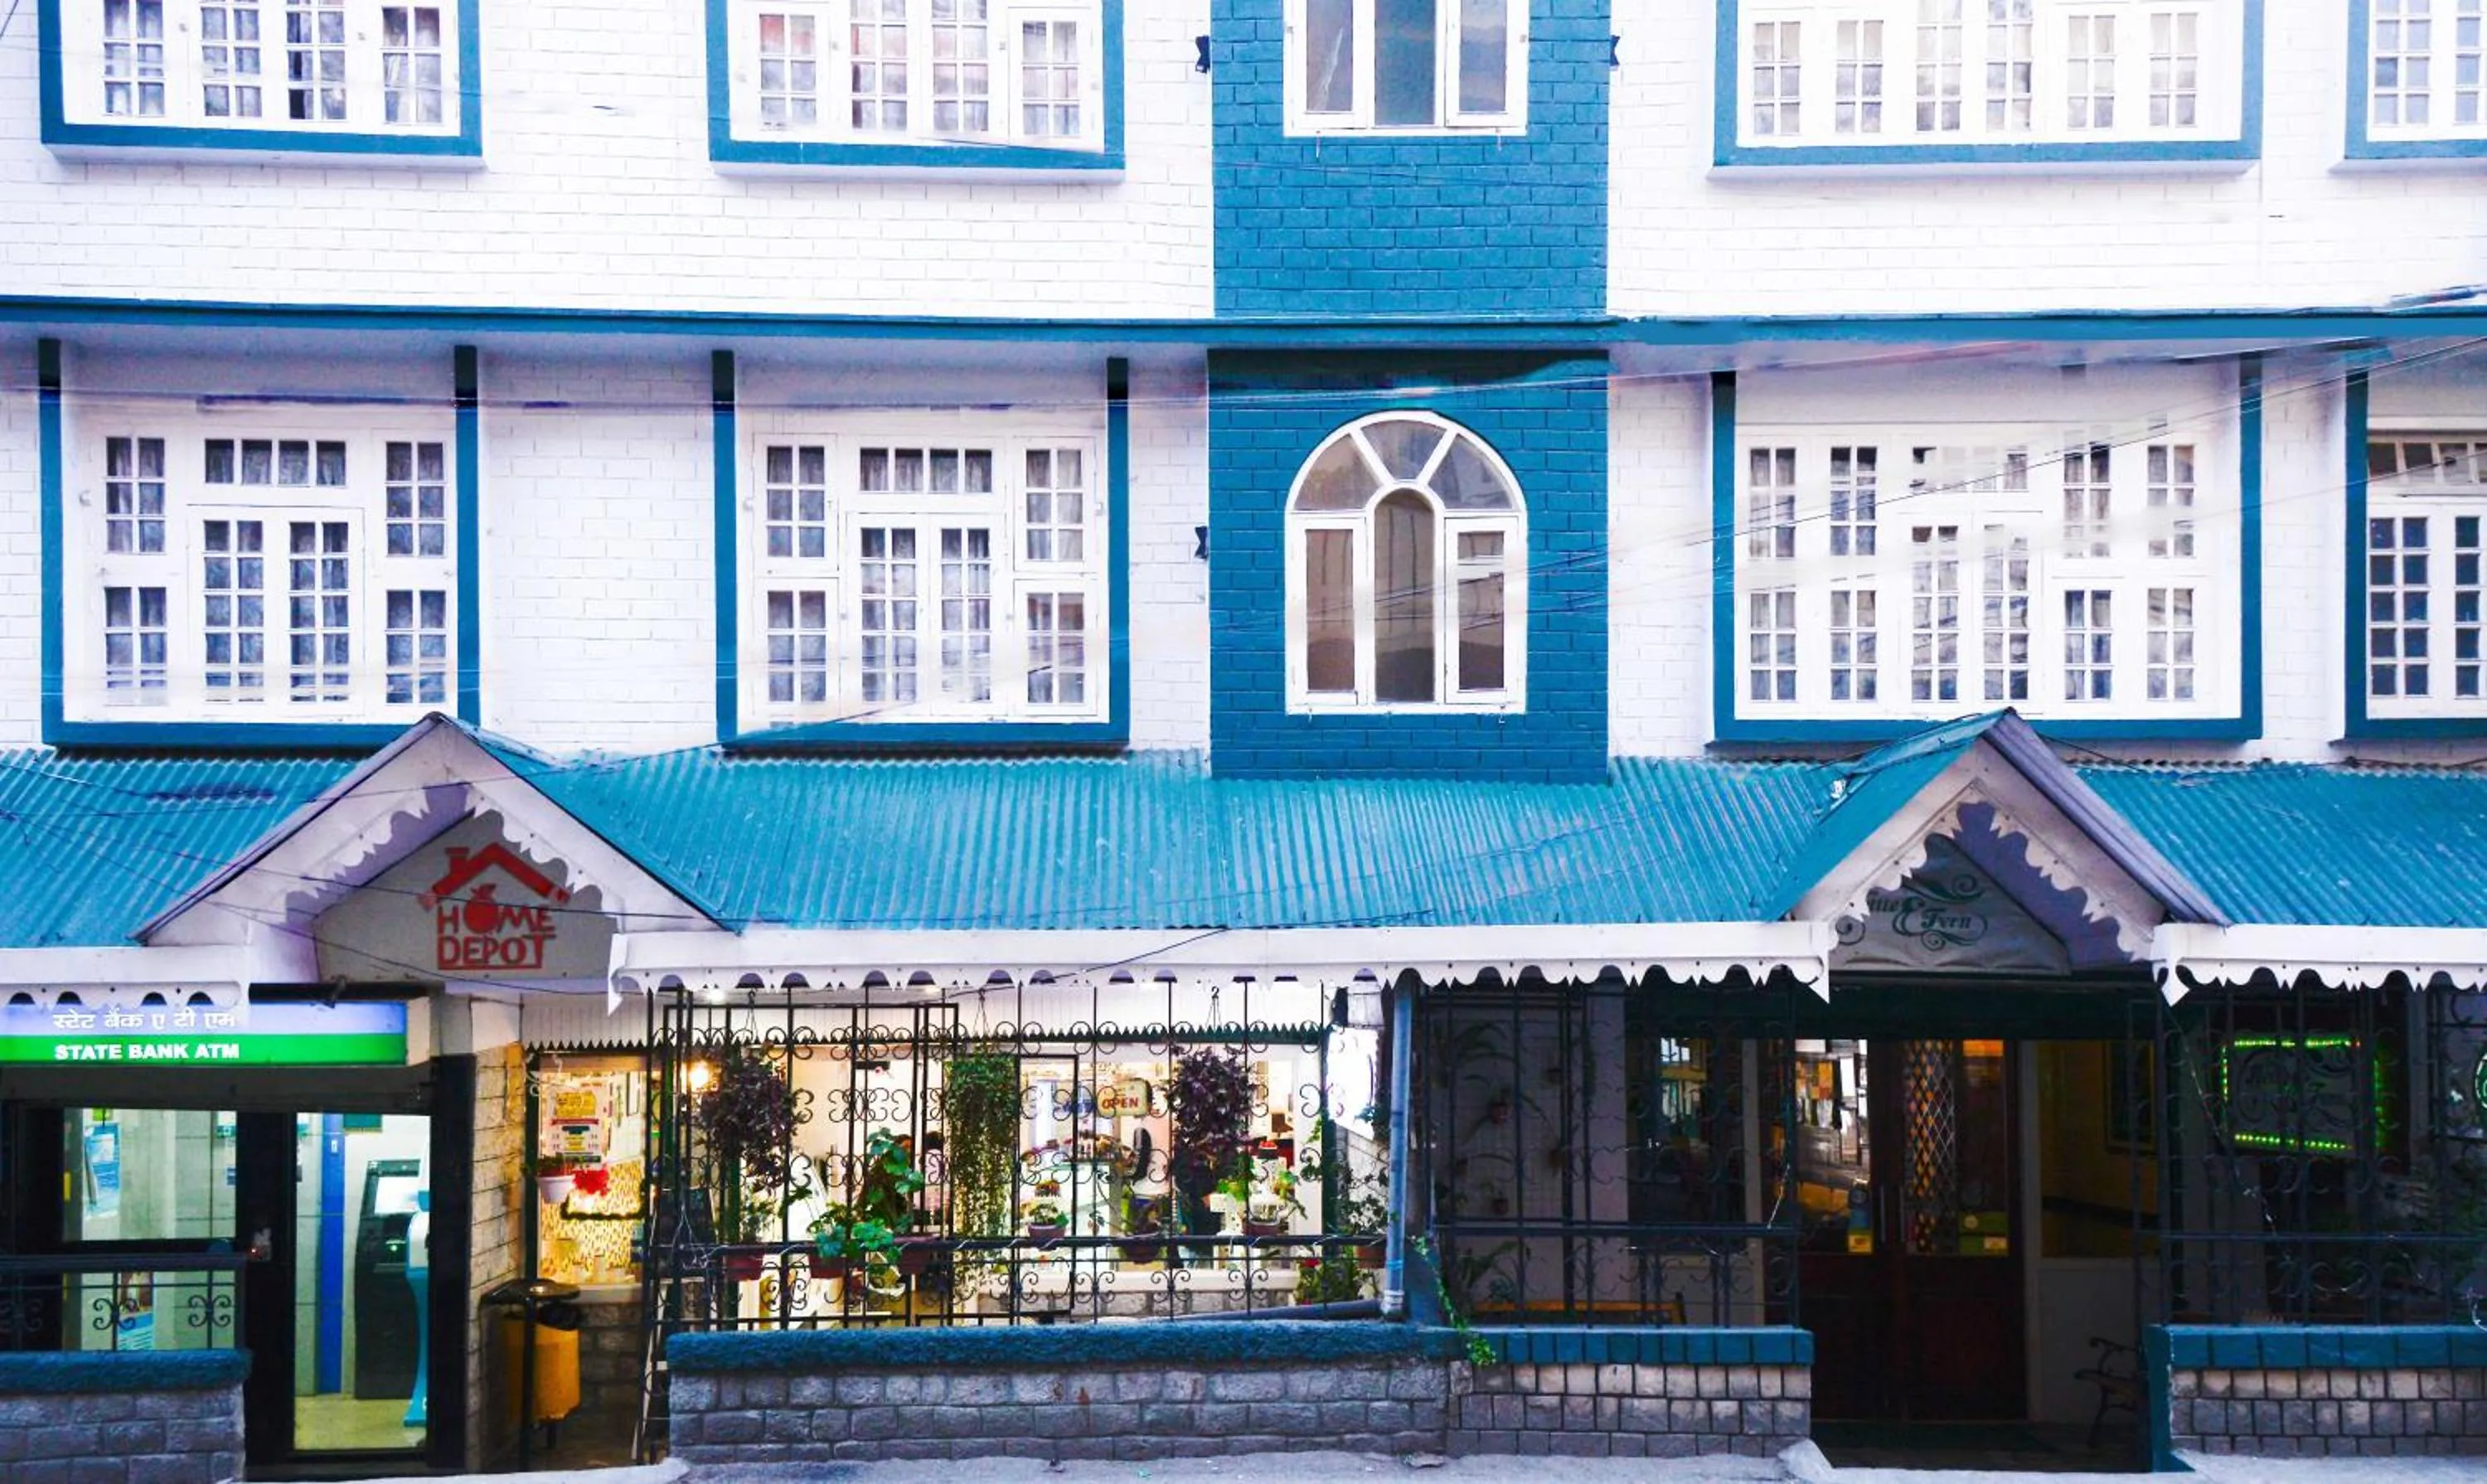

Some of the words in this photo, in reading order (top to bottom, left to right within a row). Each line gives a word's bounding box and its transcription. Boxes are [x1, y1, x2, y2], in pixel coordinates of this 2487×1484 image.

[437, 901, 555, 934] HOME
[437, 933, 556, 968] DEPOT
[52, 1008, 96, 1029] स्टेट
[103, 1006, 145, 1029] बैंक
[152, 1012, 165, 1030] ए
[173, 1006, 196, 1028] टी
[204, 1011, 235, 1029] एम
[54, 1044, 124, 1060] STATE
[128, 1044, 189, 1060] BANK
[195, 1043, 240, 1059] ATM
[1102, 1097, 1139, 1109] OPEN
